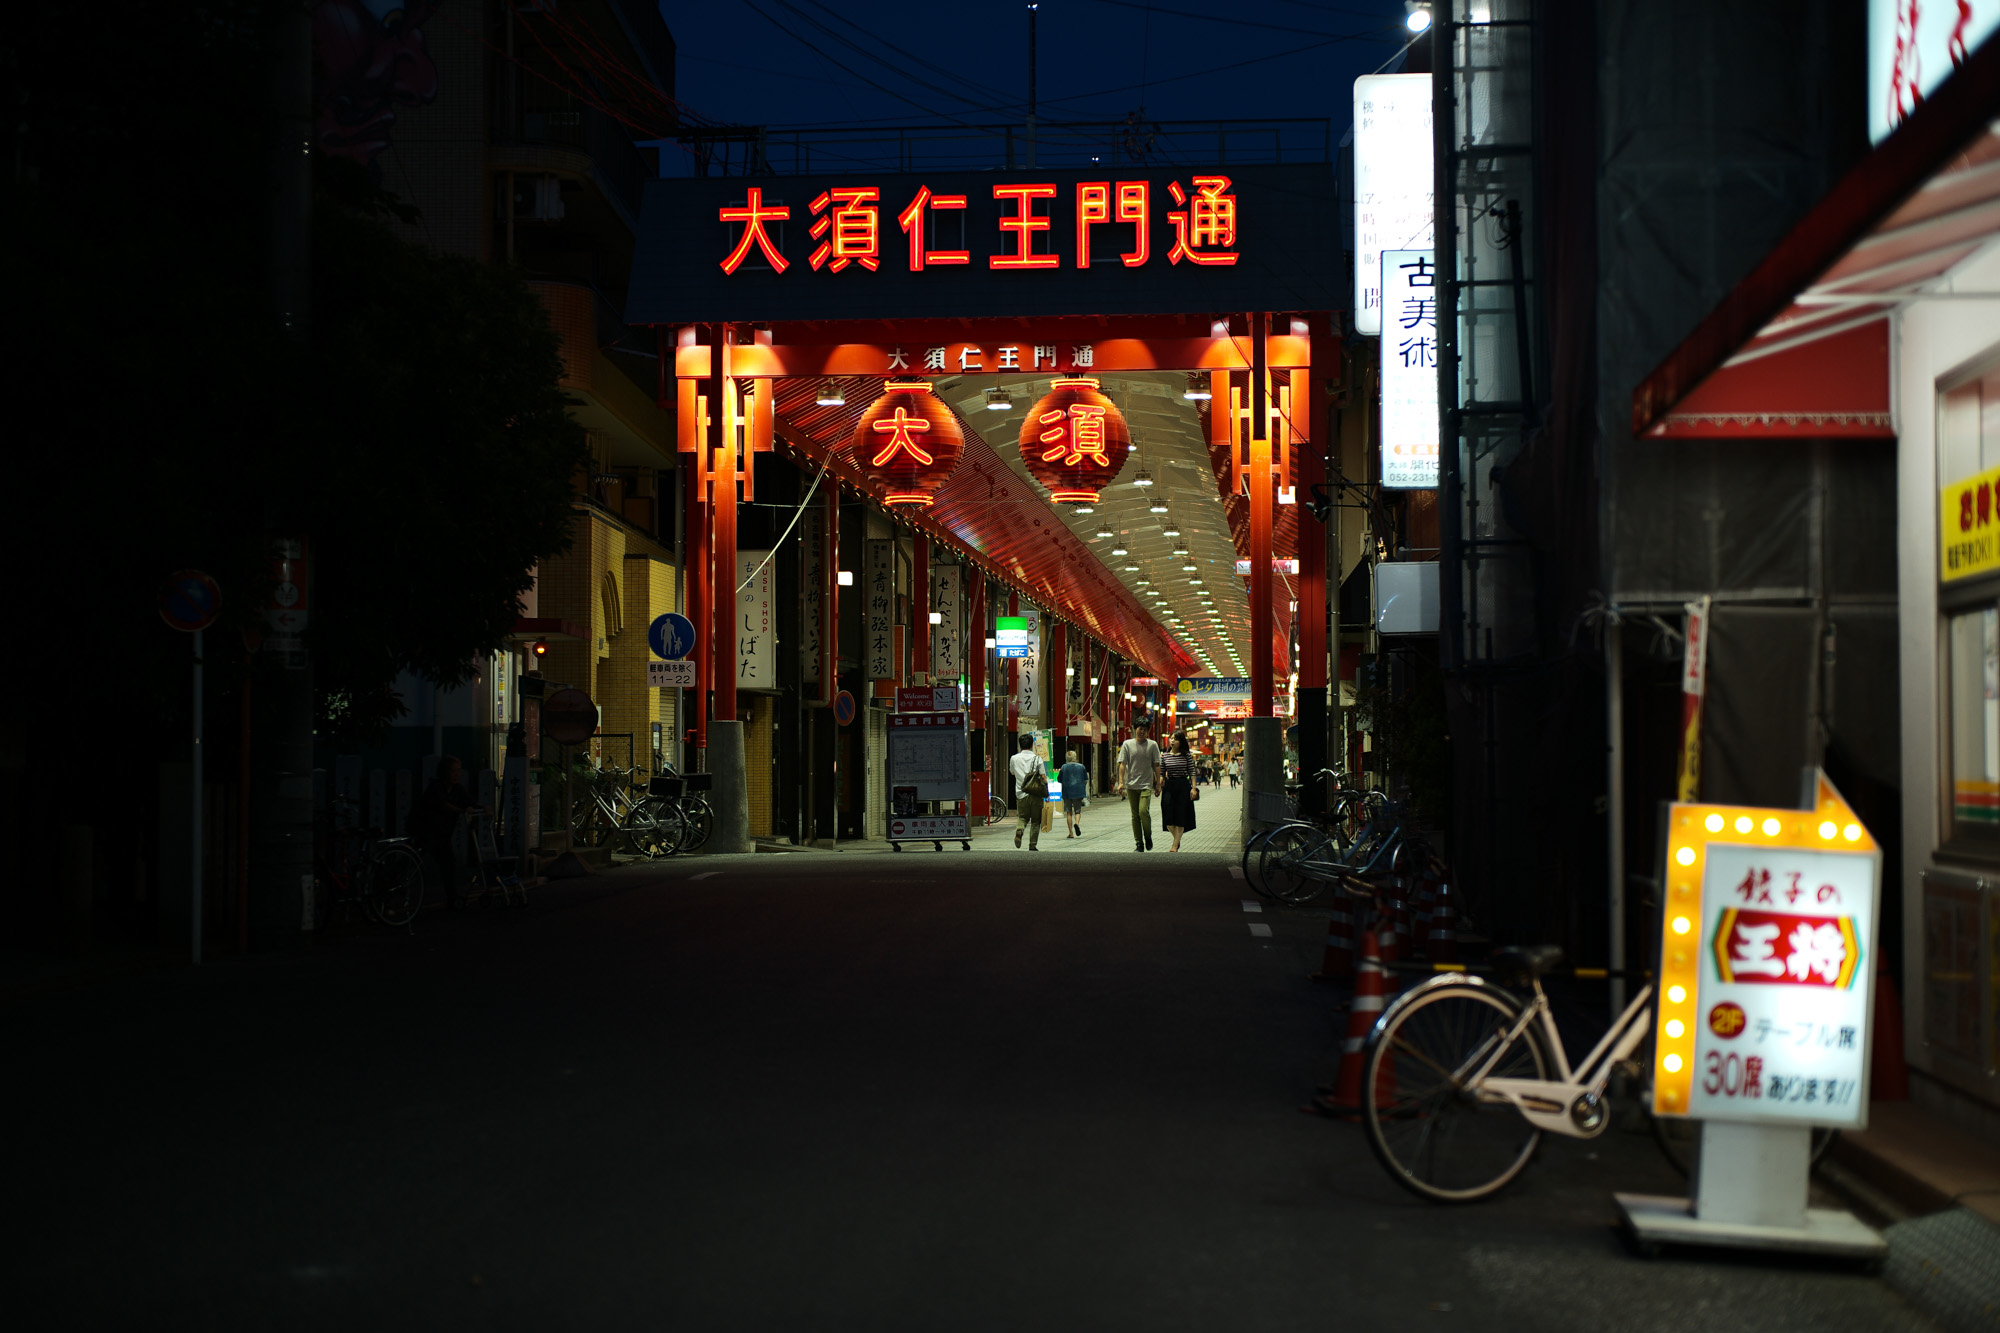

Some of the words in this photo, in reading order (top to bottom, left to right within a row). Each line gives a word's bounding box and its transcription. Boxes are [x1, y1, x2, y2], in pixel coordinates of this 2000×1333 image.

[718, 175, 1241, 275] 大須仁王門通
[1399, 256, 1438, 368] 古美術
[887, 344, 1095, 371] 大須仁王門通
[871, 406, 933, 467] 大
[1038, 403, 1110, 468] 須
[740, 614, 759, 678] しばた
[871, 571, 889, 675] 青柳総本家
[649, 664, 692, 673] 軽車両を除く
[935, 691, 955, 700] N-1
[1728, 921, 1848, 984] 王将
[1711, 1005, 1744, 1034] 2F
